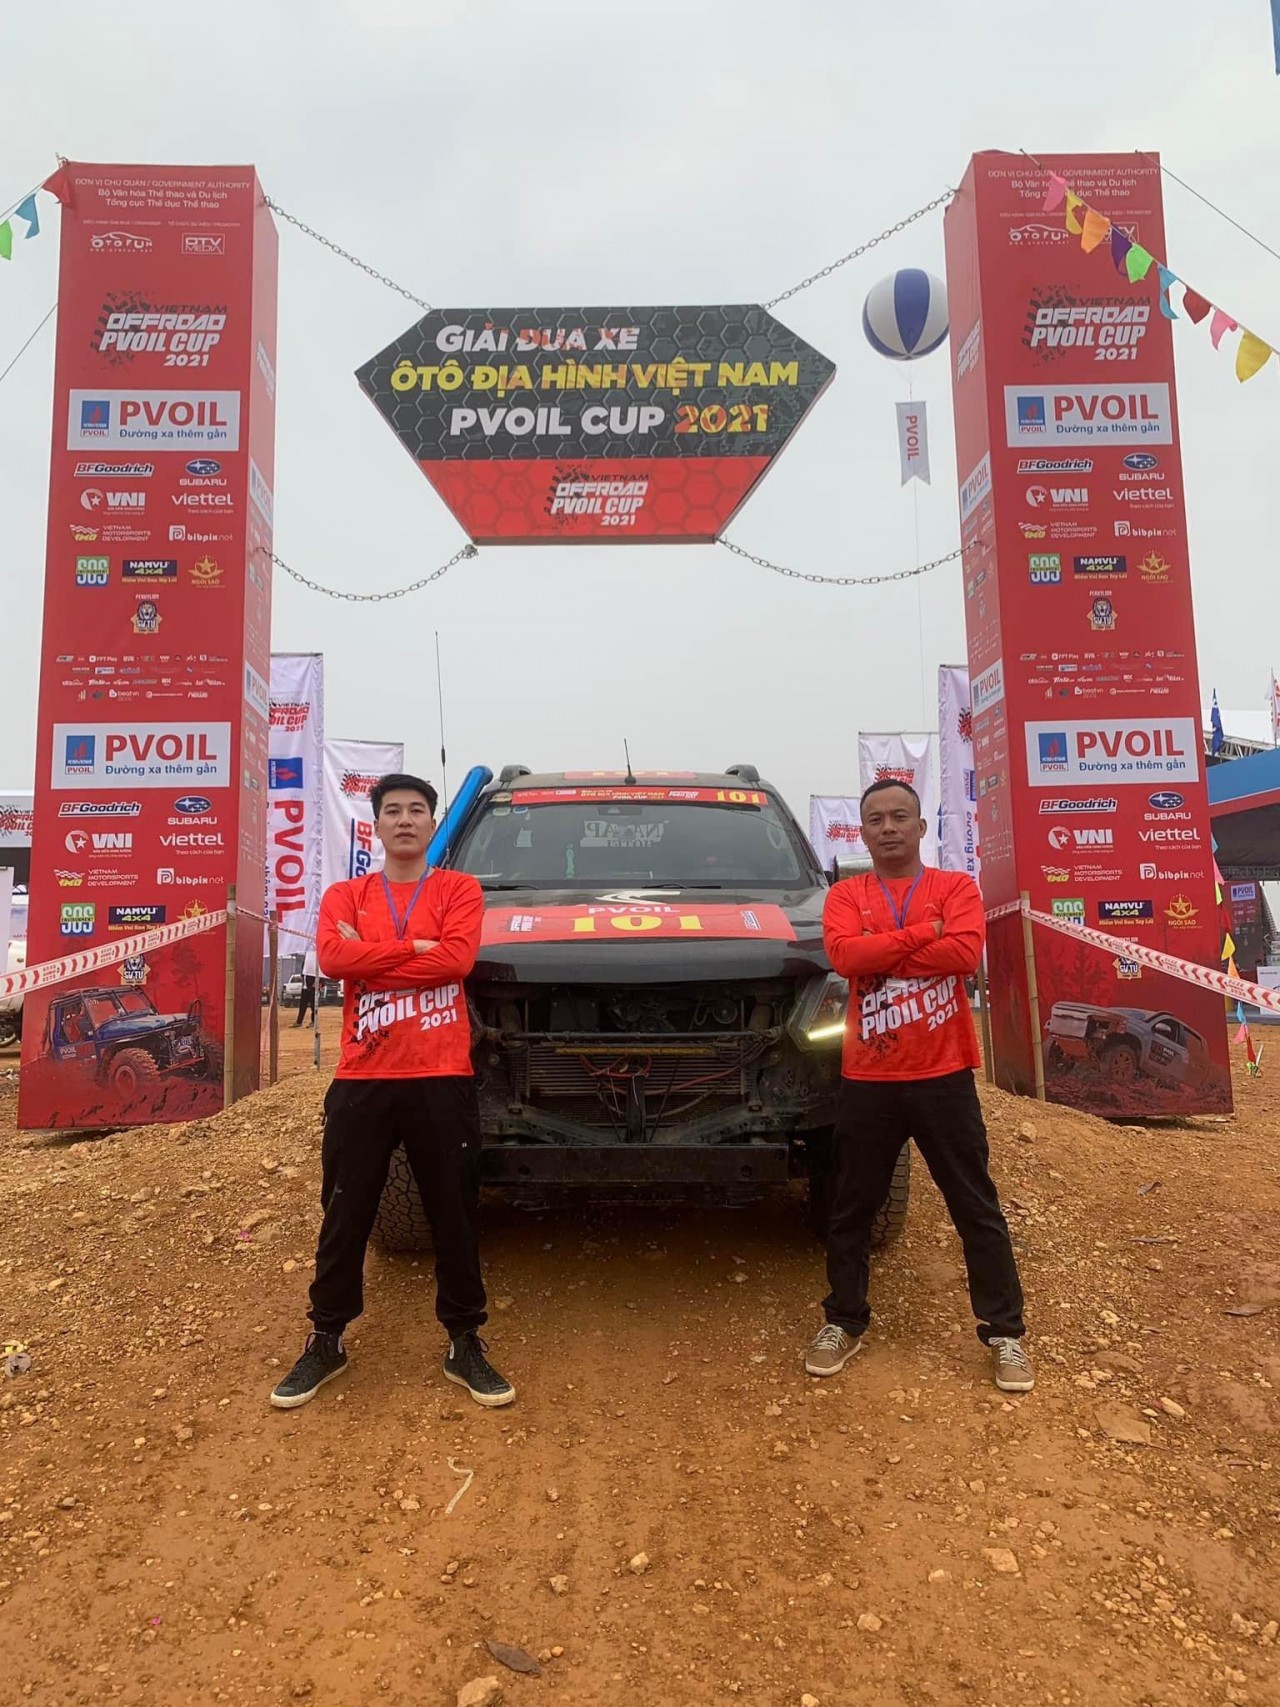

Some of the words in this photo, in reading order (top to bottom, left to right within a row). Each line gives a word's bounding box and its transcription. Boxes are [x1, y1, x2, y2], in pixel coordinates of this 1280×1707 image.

[1063, 169, 1114, 177] GOVERNMENT
[152, 180, 205, 188] GOVERNMENT
[1122, 179, 1136, 187] lịch
[166, 190, 184, 198] thao
[213, 191, 227, 200] lịch
[186, 237, 221, 245] OTV
[1079, 296, 1150, 305] VIETNAM
[153, 305, 227, 313] VIETNAM
[1035, 306, 1150, 325] OFFROAD
[107, 314, 227, 330] OFFROAD
[99, 332, 165, 351] PVOIL
[170, 333, 220, 351] CUP
[593, 327, 640, 351] XE
[1030, 325, 1095, 347] PVOIL
[1100, 325, 1146, 345] CUP
[163, 354, 209, 366] 2021
[1094, 347, 1137, 360] 2021
[390, 360, 464, 391] ÔTÔ
[471, 364, 533, 398] ĐỊA
[541, 358, 627, 389] HÌNH
[631, 357, 713, 396] VIỆT
[717, 362, 799, 386] NAM
[120, 401, 227, 426] PVOIL
[1054, 395, 1159, 421] PVOIL
[450, 406, 572, 436] PVOIL
[581, 406, 666, 436] CUP
[674, 403, 769, 433] 2021
[120, 429, 158, 439] Đường
[177, 429, 204, 438] thêm
[207, 429, 227, 439] gần
[1056, 423, 1093, 435] Đường
[1112, 423, 1137, 432] thêm
[1141, 421, 1160, 434] gần
[906, 415, 919, 461] PVOIL
[76, 463, 153, 473] BFGoodrich
[1019, 460, 1091, 470] BFGoodrich
[554, 481, 649, 497] OFFROAD
[1050, 488, 1088, 503] VNI
[1113, 488, 1173, 501] viettel
[107, 492, 145, 506] VNI
[172, 493, 234, 506] viettel
[550, 497, 603, 514] PVOIL
[605, 497, 645, 513] CUP
[600, 515, 636, 526] 2021
[980, 669, 1001, 696] PVOIL
[287, 715, 307, 725] CUP
[105, 734, 217, 761] PVOIL
[1076, 730, 1184, 758] PVOIL
[105, 765, 145, 776] Đường
[165, 765, 193, 774] thêm
[196, 764, 217, 776] gần
[1079, 761, 1117, 773] Đường
[1136, 760, 1162, 770] thêm
[1166, 759, 1186, 771] gần
[716, 790, 760, 804] 101
[1041, 798, 1116, 810] BFGoodrich
[61, 803, 140, 812] BFGoodrich
[168, 817, 218, 825] SUBARU
[1144, 812, 1191, 820] SUBARU
[92, 833, 133, 848] VNI
[160, 833, 224, 846] viettel
[1073, 829, 1113, 845] VNI
[1138, 827, 1200, 842] viettel
[274, 800, 306, 923] PVOIL
[588, 906, 680, 914] PVOIL
[1105, 902, 1143, 910] NAMVU
[572, 914, 704, 932] 101
[356, 995, 417, 1040] PVOIL
[420, 984, 460, 1013] CUP
[862, 998, 923, 1040] PVOIL
[923, 975, 957, 1013] CUP
[928, 998, 959, 1031] 2021
[420, 1008, 458, 1031] 2021
